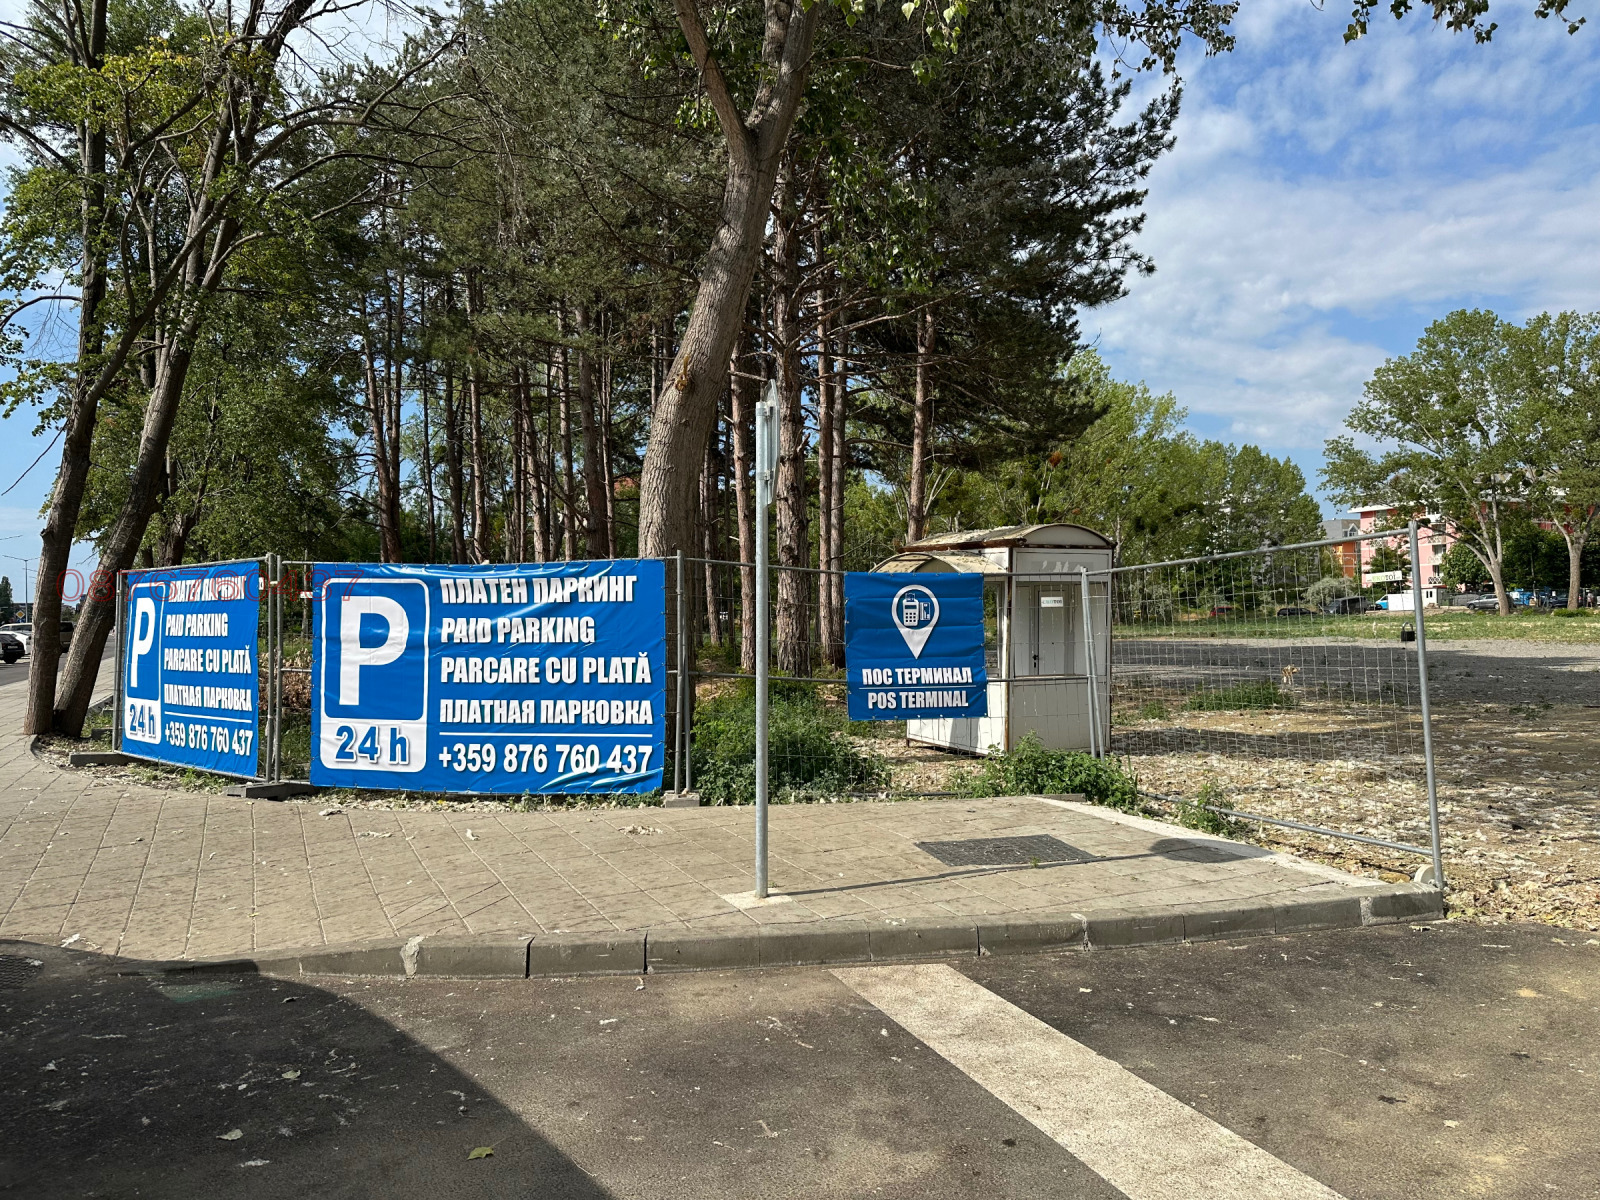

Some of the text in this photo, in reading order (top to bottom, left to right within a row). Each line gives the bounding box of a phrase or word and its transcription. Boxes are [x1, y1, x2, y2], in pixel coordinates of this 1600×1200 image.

[440, 575, 638, 604] ПЛАТЕН ПАРКИНГ
[165, 612, 229, 637] PAID PARKING
[440, 616, 595, 643] PAID PARKING
[130, 597, 155, 688] P
[339, 595, 410, 706] P
[163, 644, 252, 674] PARCARE CU PLATĂ
[440, 651, 652, 684] PARCARE CU PLATĂ
[861, 667, 973, 685] ПОС ТЕРМИНАЛ
[163, 683, 252, 712] ПЛАТНАЯ ПАРКОВКА
[439, 698, 654, 725] ПЛАТНАЯ ПАРКОВКА
[867, 690, 969, 709] POS TERMINAL
[129, 703, 146, 737] 24
[164, 721, 254, 756] +359 876 760 437
[335, 724, 409, 765] 24 h
[438, 743, 653, 775] +359 876 760 437
